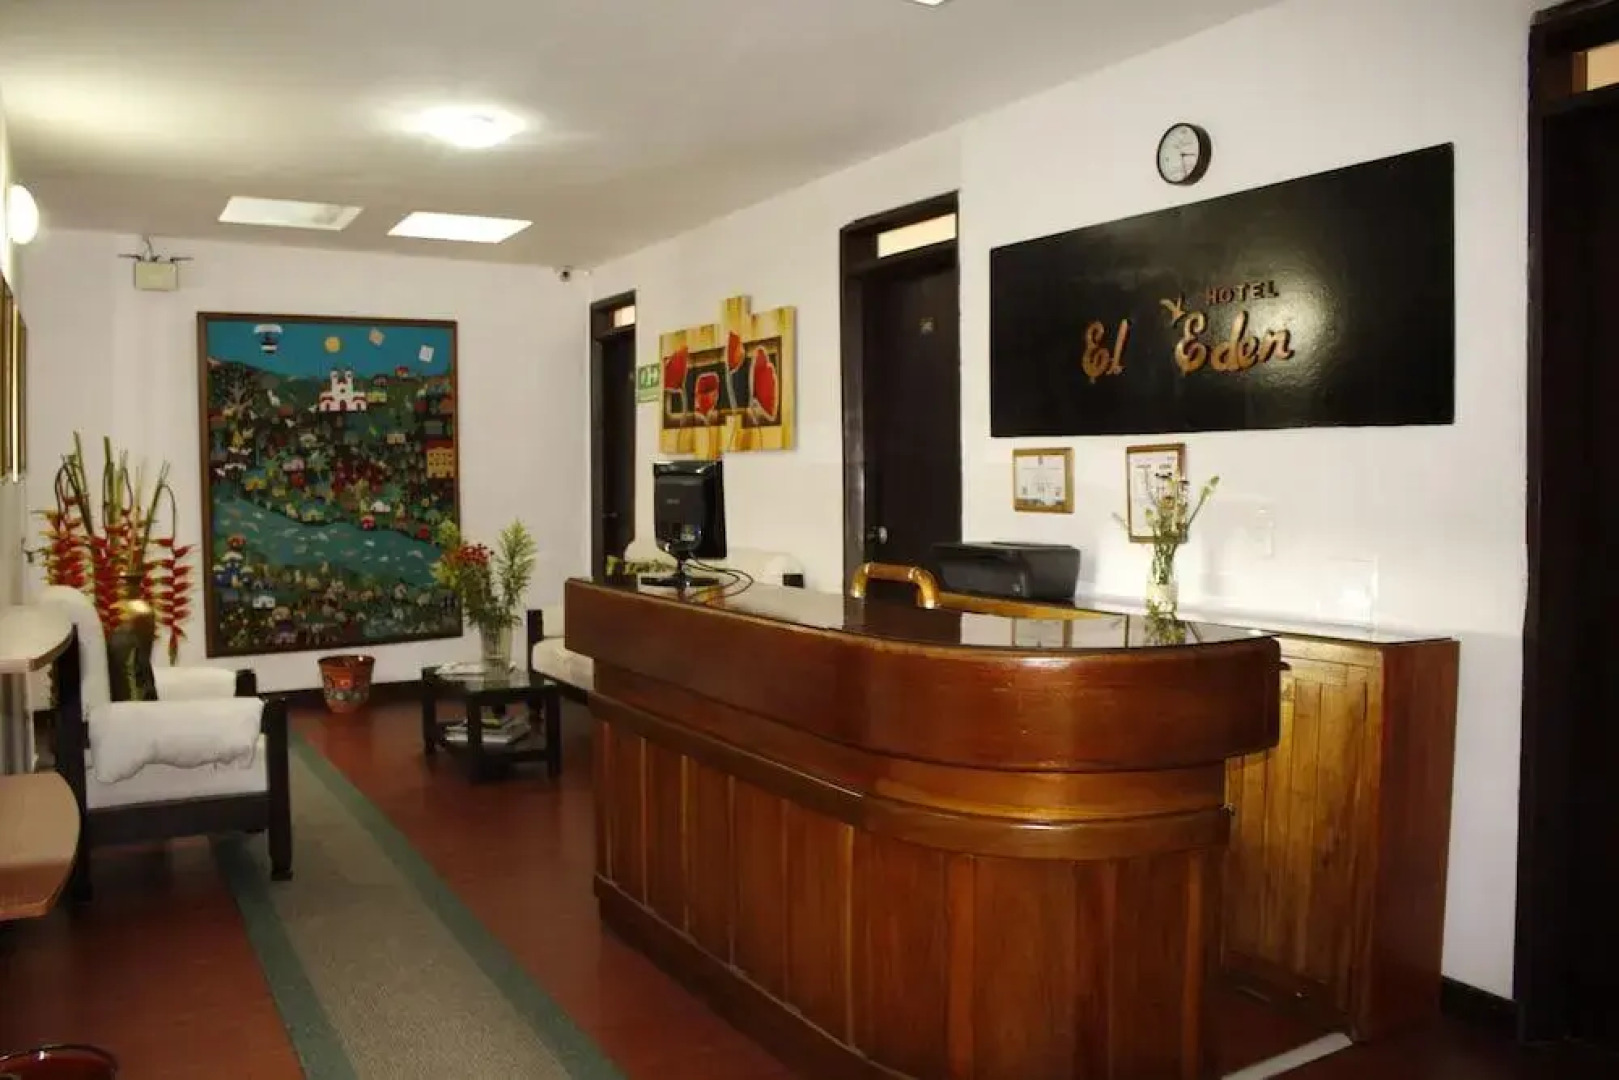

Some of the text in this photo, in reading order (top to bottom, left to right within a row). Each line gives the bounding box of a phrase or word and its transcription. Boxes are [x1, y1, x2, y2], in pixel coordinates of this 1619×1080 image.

[1207, 280, 1279, 305] HOTEL
[1082, 310, 1294, 381] El Eden
